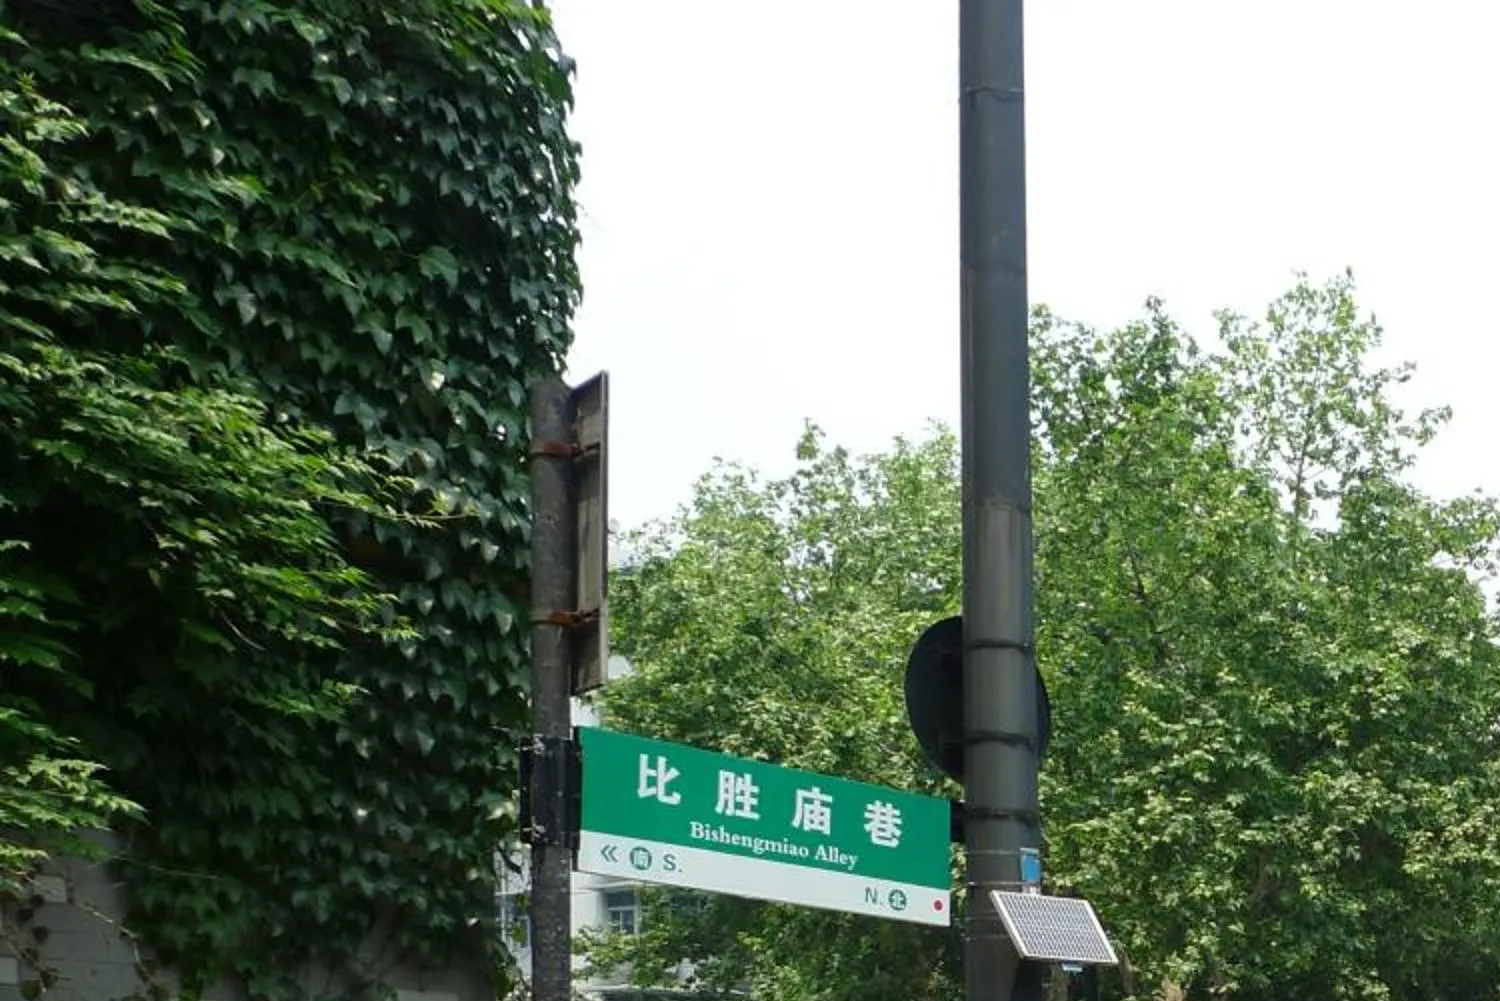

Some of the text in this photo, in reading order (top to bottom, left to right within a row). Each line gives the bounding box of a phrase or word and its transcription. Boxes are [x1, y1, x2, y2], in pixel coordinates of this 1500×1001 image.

[637, 753, 902, 848] 比胜庙巷
[630, 846, 682, 872] 南 S.
[690, 821, 858, 870] Bishengmiao Alley
[864, 887, 906, 910] N. 北
